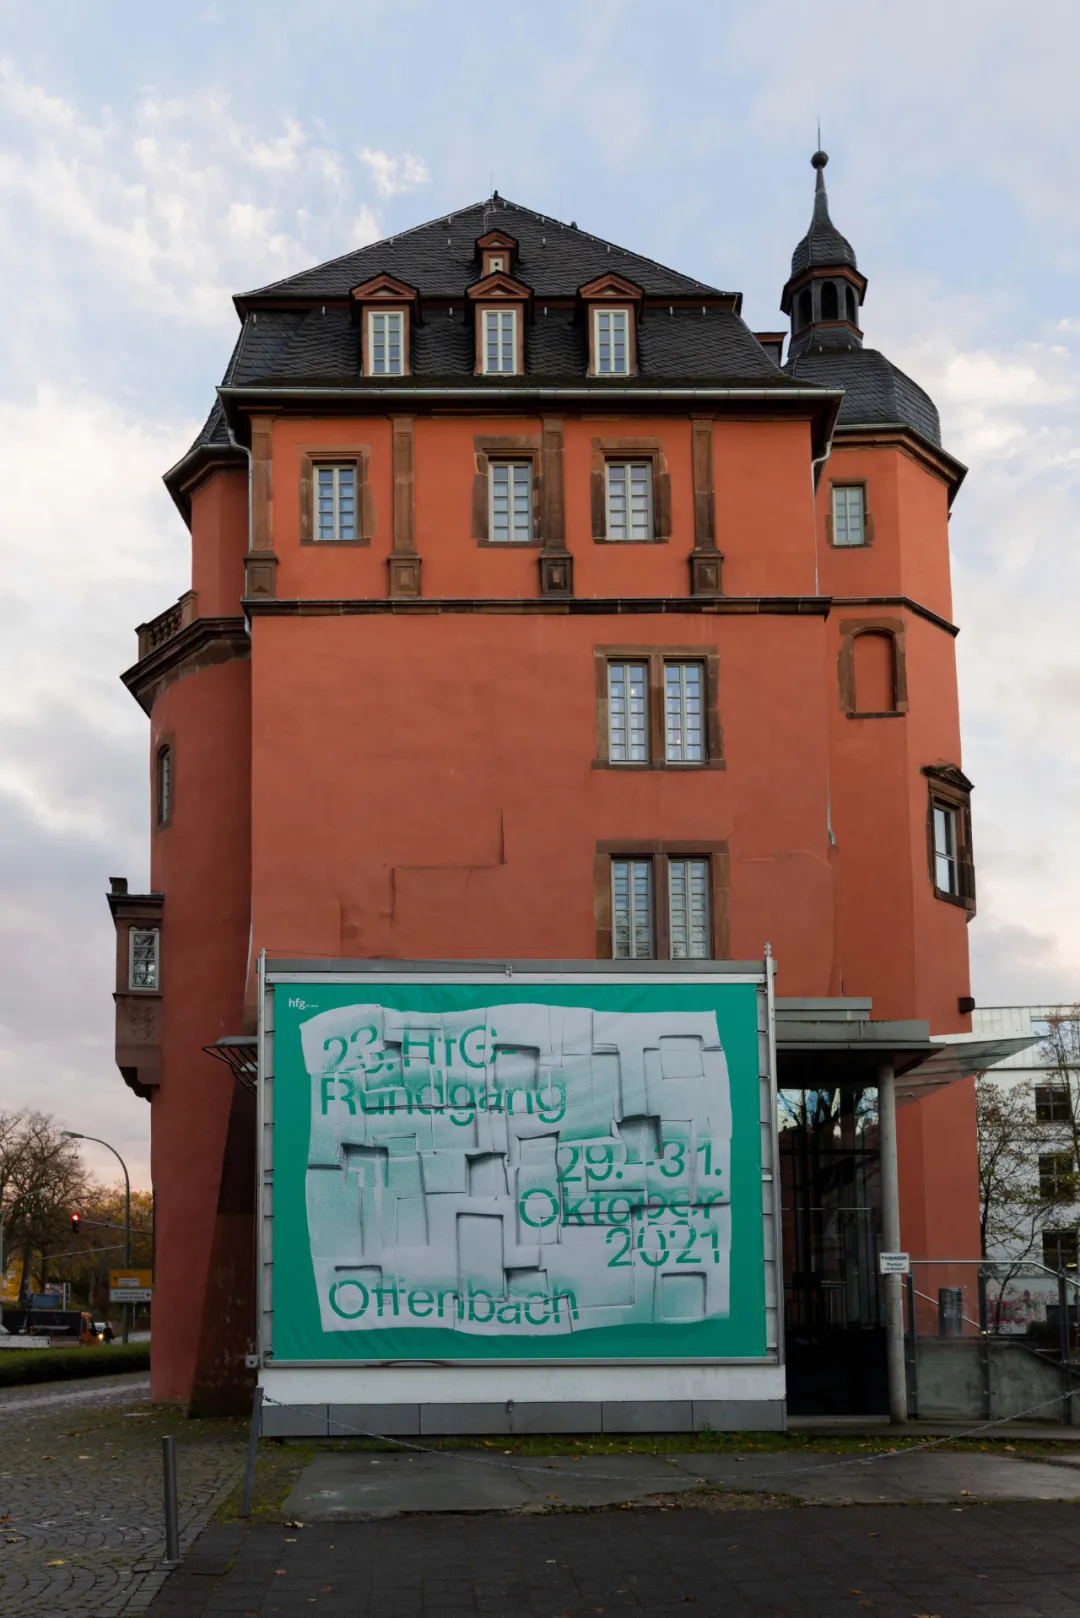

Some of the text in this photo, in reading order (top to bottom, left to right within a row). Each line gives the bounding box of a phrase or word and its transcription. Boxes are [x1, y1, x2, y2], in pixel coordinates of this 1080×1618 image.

[288, 997, 306, 1010] hfg
[321, 1070, 566, 1126] Rundgang
[519, 1187, 724, 1228] Oktober
[605, 1221, 720, 1268] 2021
[328, 1278, 580, 1325] Offenbach
